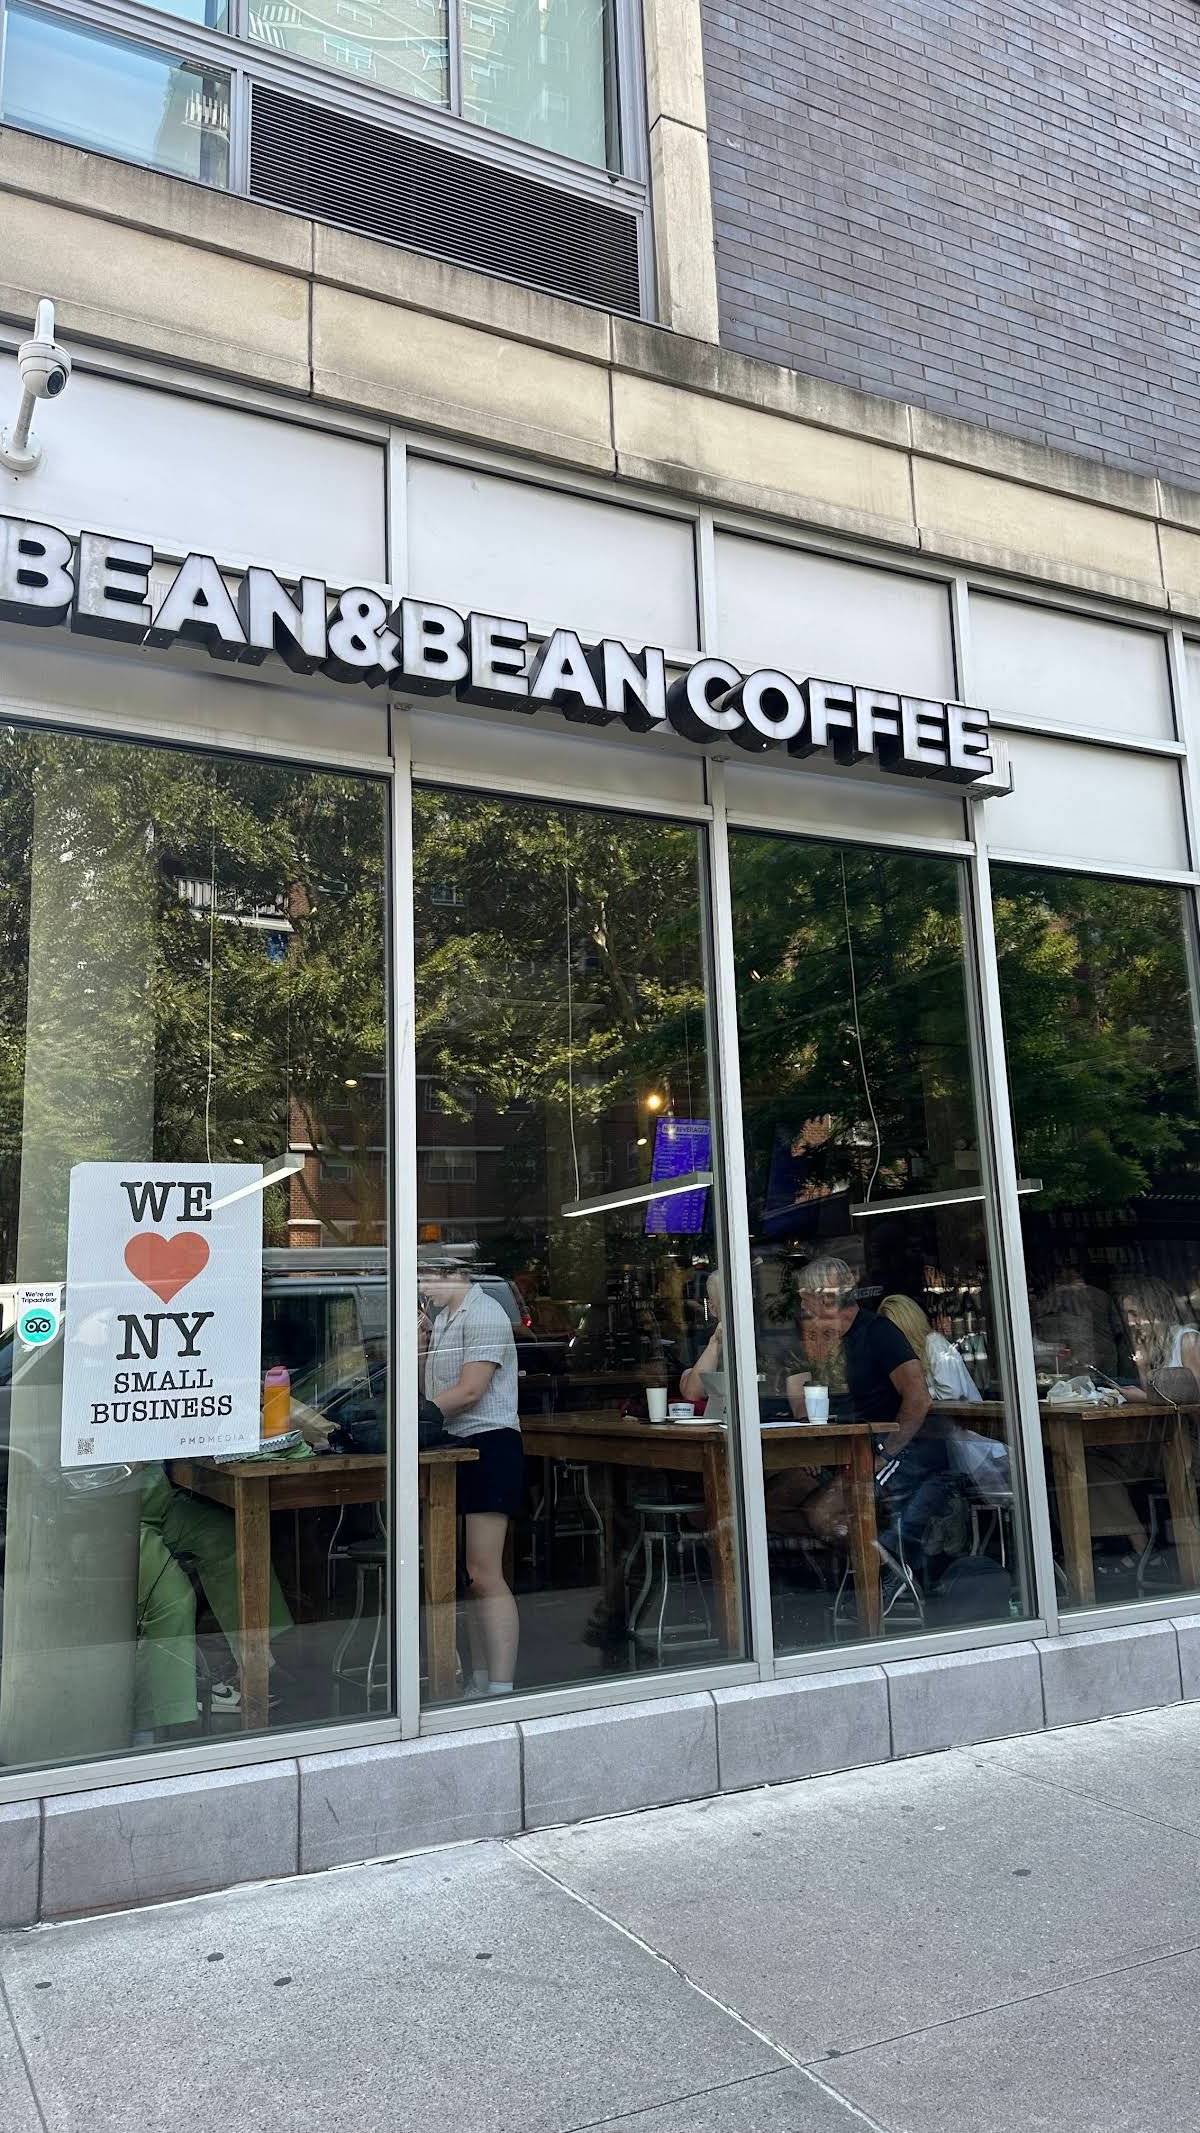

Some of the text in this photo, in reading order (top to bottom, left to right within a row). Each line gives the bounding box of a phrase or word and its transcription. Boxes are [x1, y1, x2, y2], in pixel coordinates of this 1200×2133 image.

[0, 515, 994, 780] BEAN&BEAN COFFEE
[120, 1181, 212, 1223] WE
[116, 1311, 214, 1360] NY
[114, 1368, 213, 1394] SMALL
[90, 1395, 233, 1425] BUSINESS
